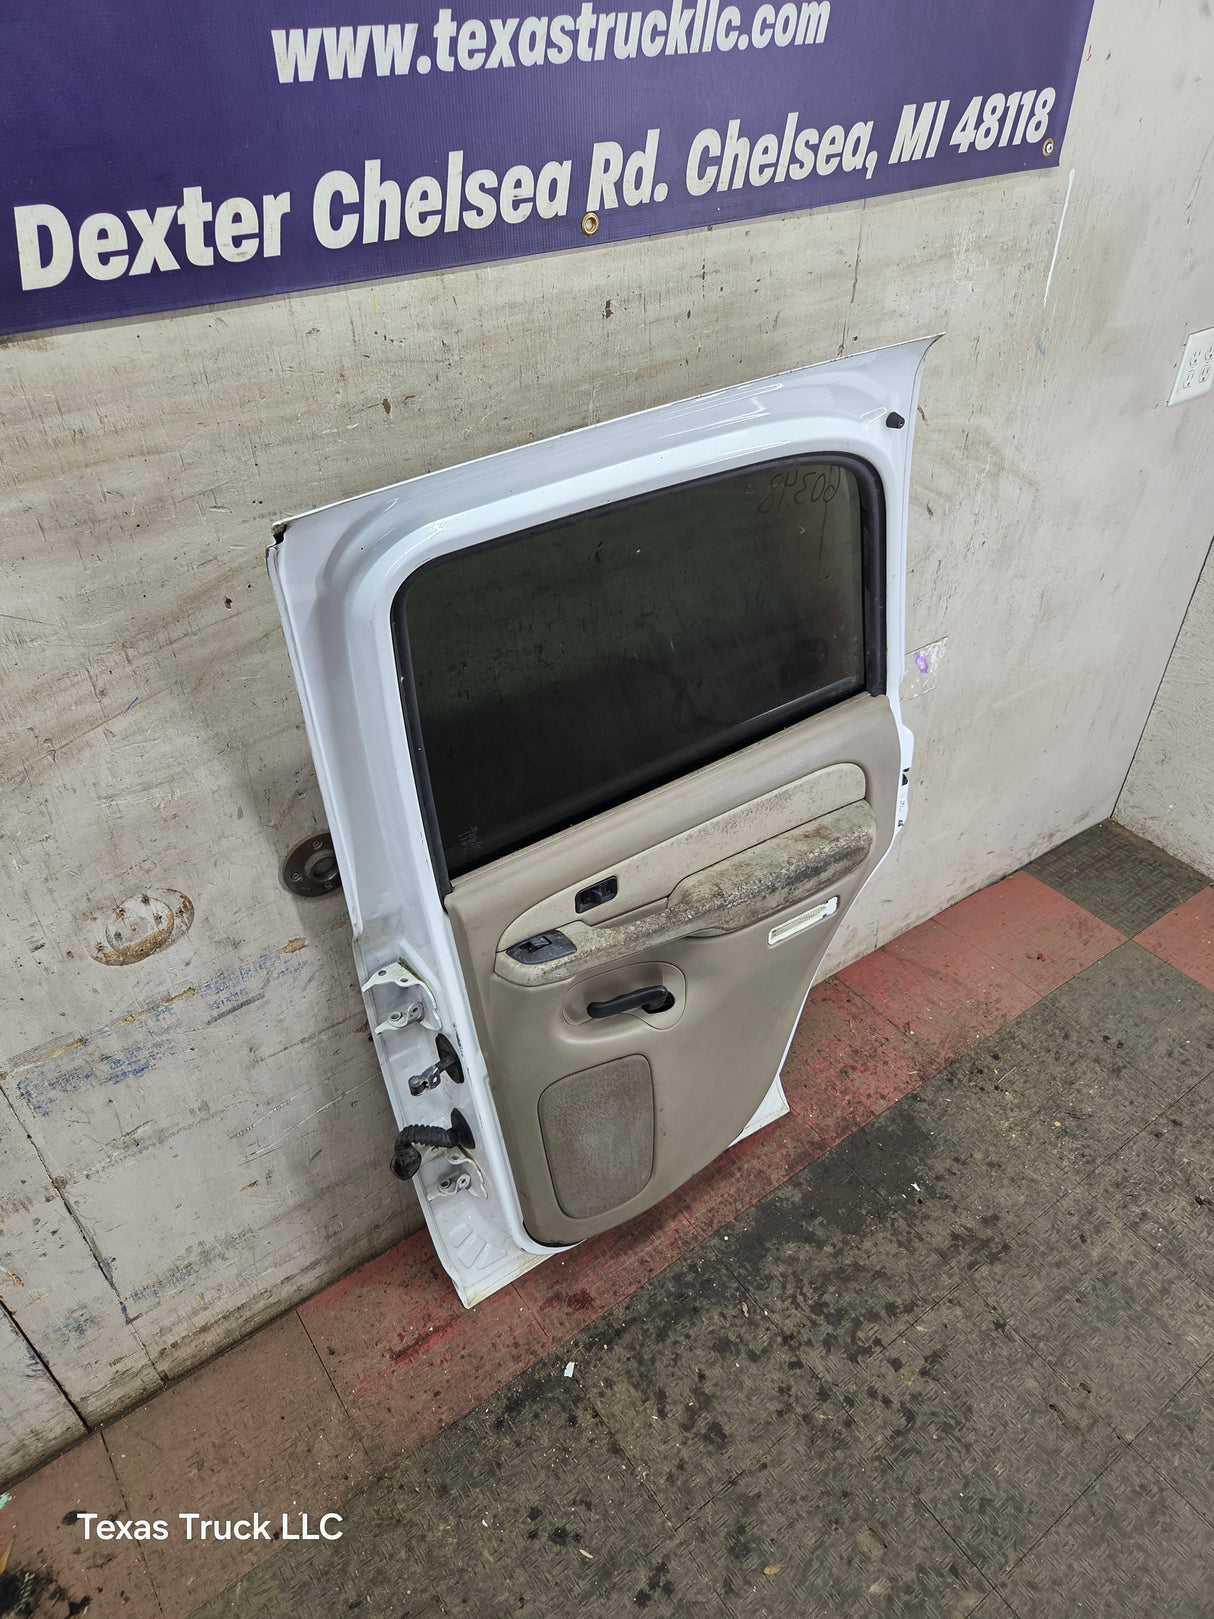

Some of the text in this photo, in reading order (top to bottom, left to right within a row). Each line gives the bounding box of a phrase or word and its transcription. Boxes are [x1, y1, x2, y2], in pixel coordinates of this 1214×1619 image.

[271, 0, 831, 84] www.texastruckllc.com
[14, 87, 1056, 291] Dexter Chelsea Rd. Chelsea, MI 48118
